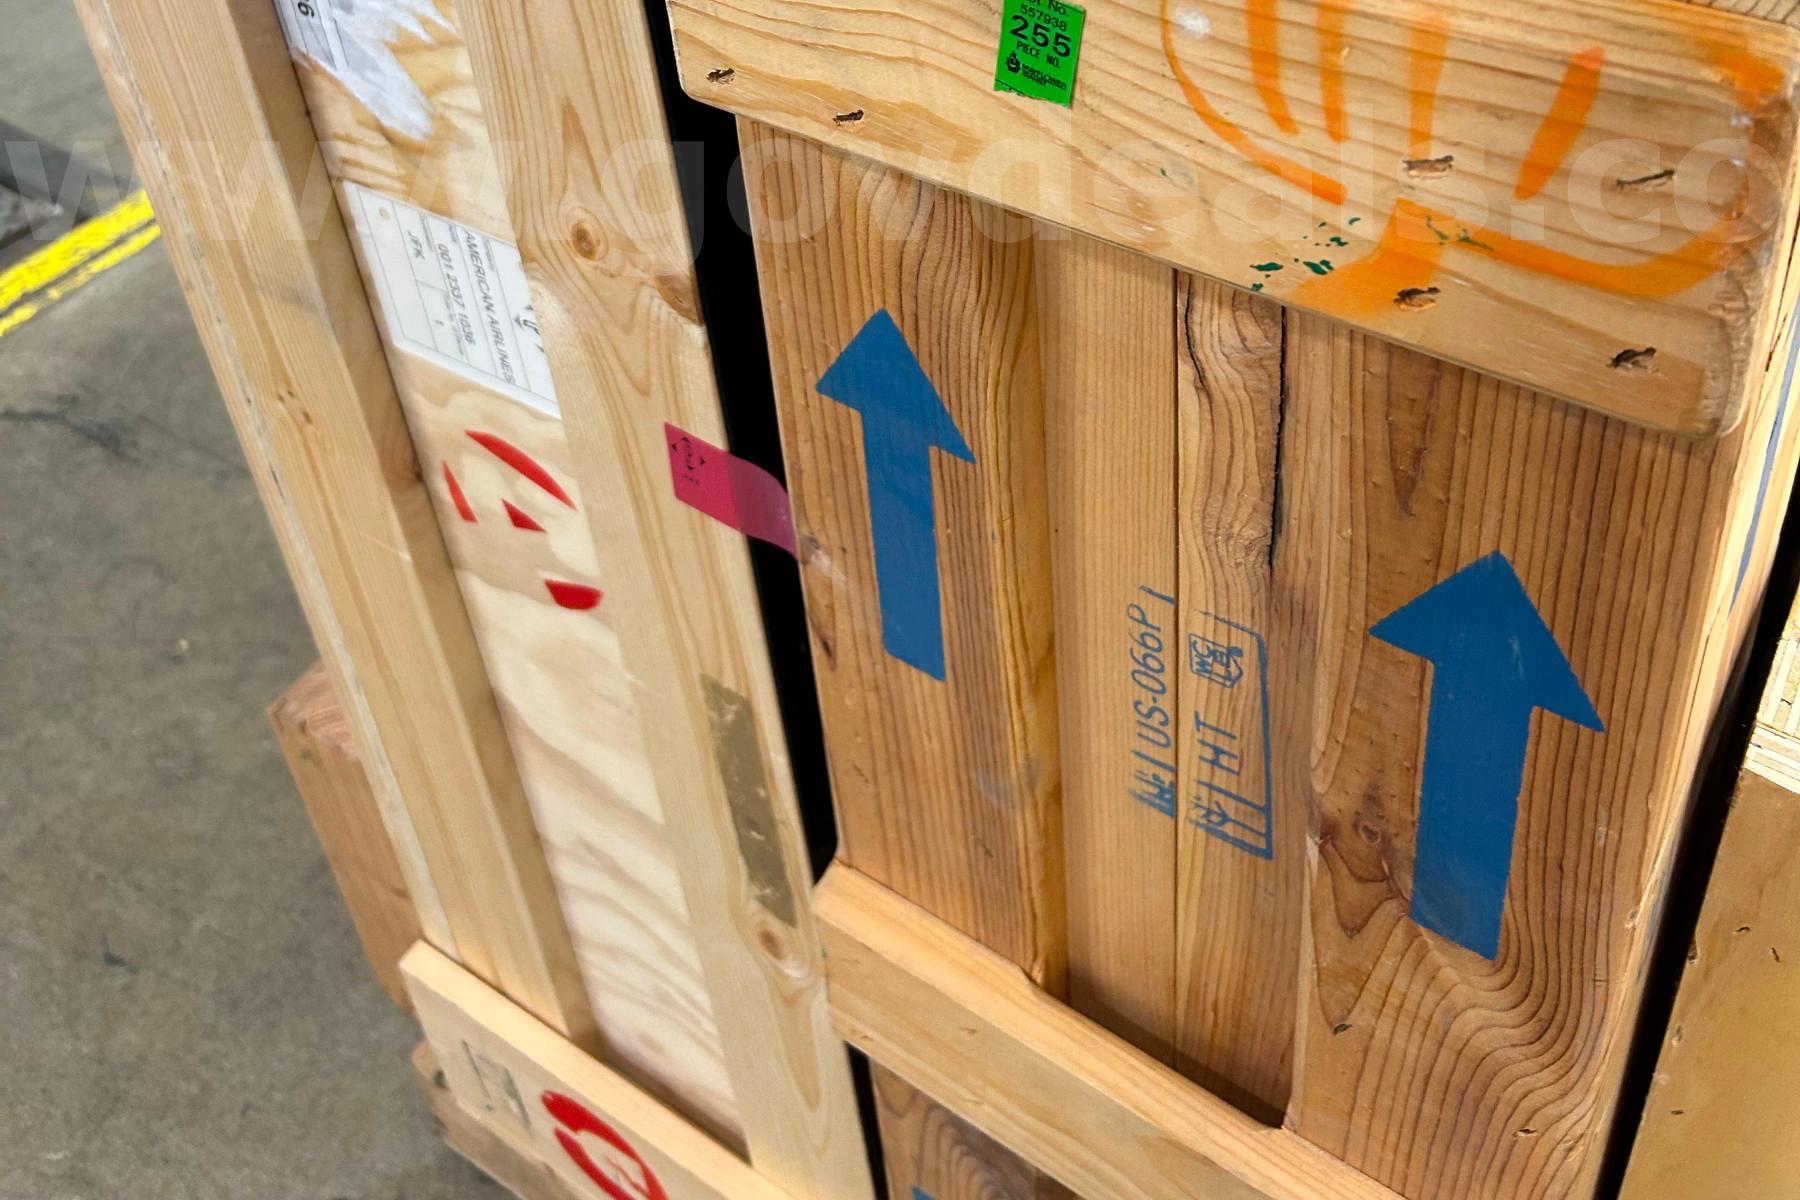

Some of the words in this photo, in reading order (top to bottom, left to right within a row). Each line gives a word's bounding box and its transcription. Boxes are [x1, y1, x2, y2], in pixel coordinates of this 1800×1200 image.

[1009, 14, 1072, 58] 255
[1020, 4, 1068, 32] 557938
[1016, 40, 1041, 59] PIECE
[408, 230, 426, 260] JFK
[463, 229, 496, 313] AMERICAN
[487, 313, 517, 386] AIRLINES
[1126, 602, 1172, 749] US-066P
[1194, 709, 1241, 776] HT
